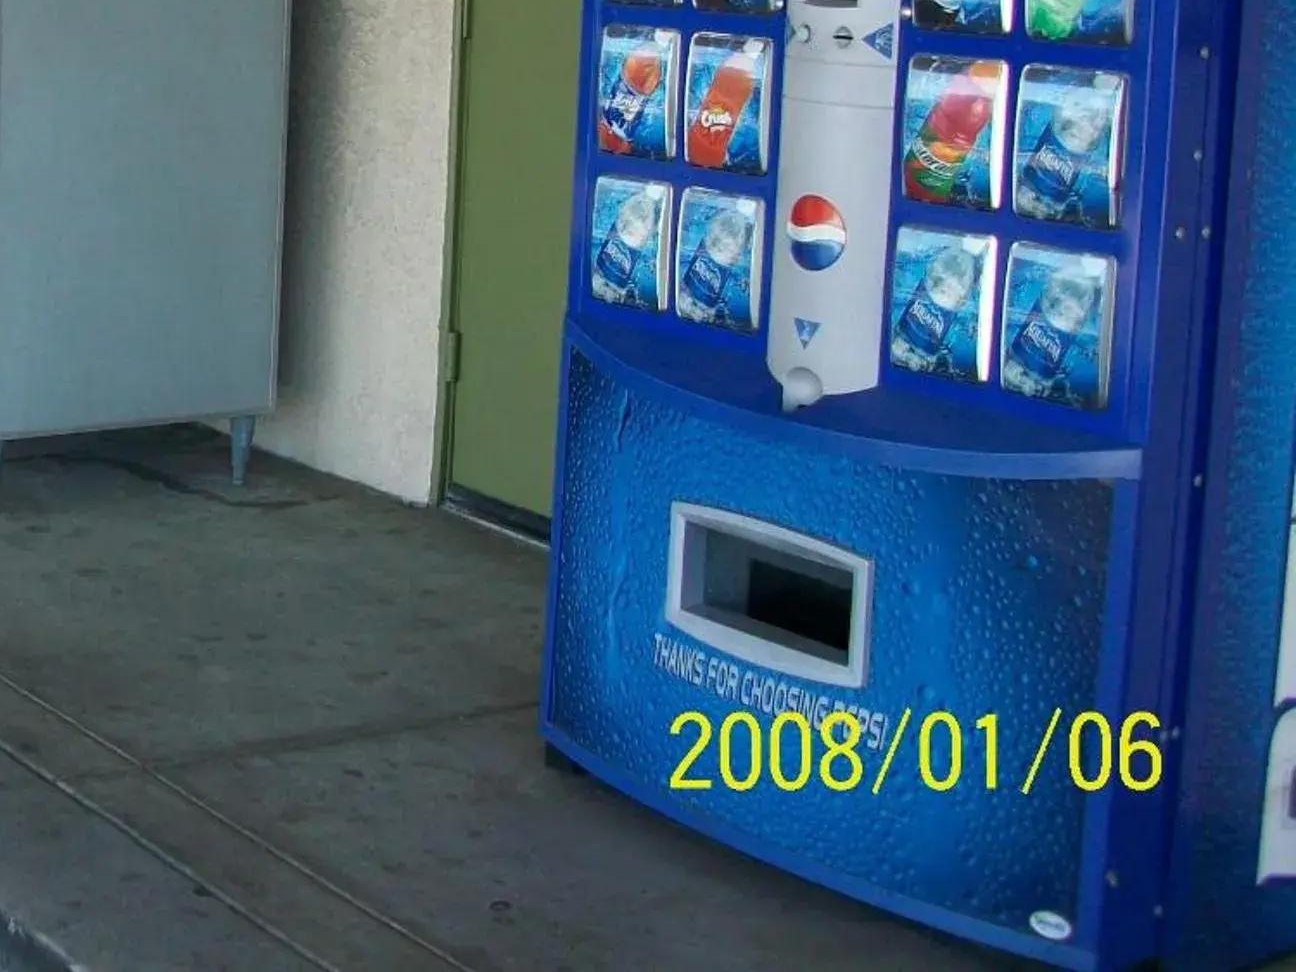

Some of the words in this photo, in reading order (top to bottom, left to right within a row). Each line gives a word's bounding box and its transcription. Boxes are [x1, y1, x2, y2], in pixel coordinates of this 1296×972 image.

[654, 633, 704, 685] THANKS
[706, 658, 739, 700] FOR
[741, 671, 830, 728] CHOOSING
